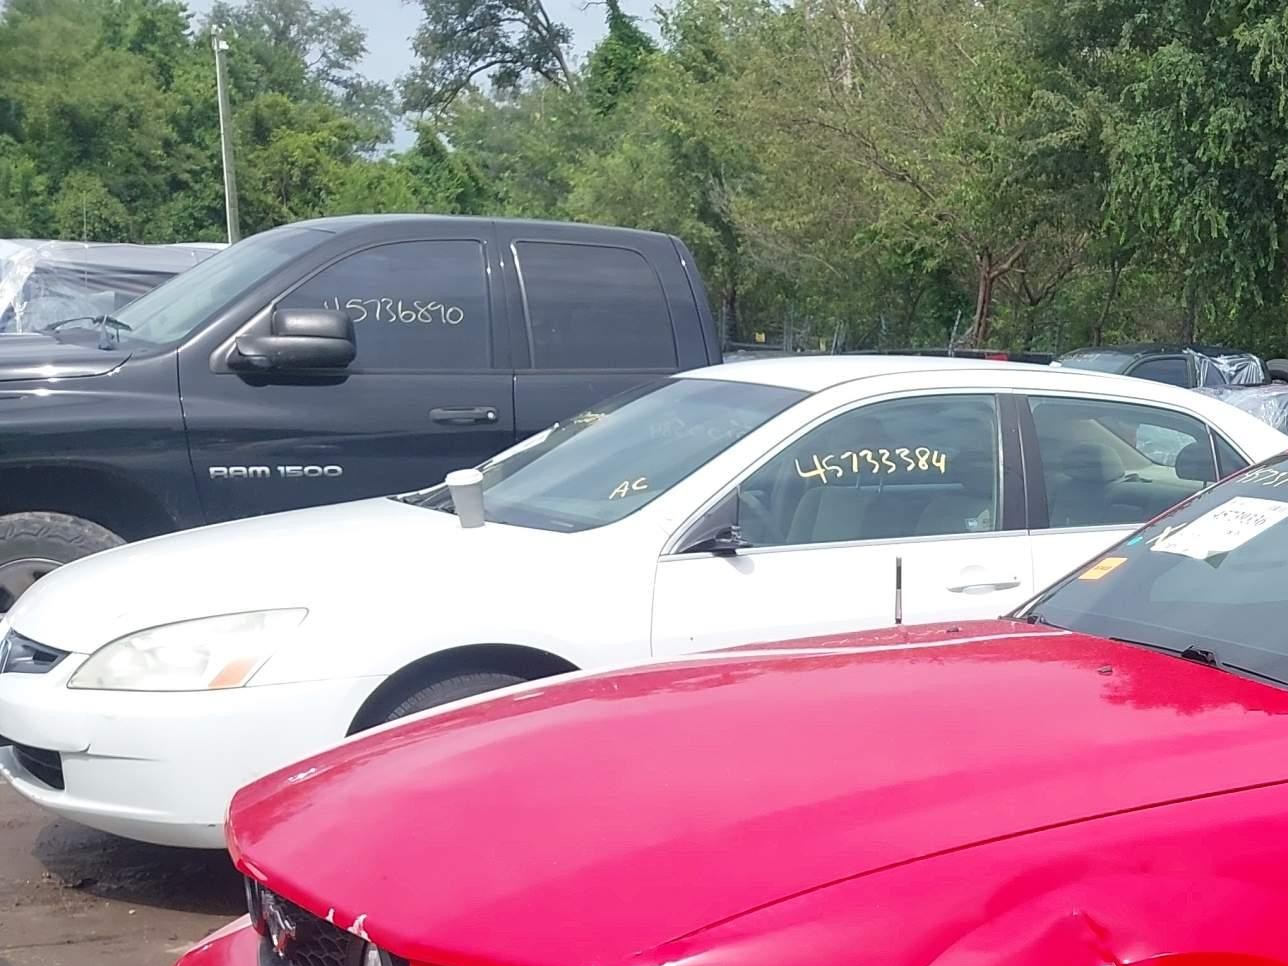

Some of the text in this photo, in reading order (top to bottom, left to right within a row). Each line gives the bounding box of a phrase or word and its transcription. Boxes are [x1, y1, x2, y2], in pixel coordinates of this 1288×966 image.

[208, 465, 343, 479] RAM 1500
[794, 447, 946, 484] 45733384
[608, 477, 649, 499] AC
